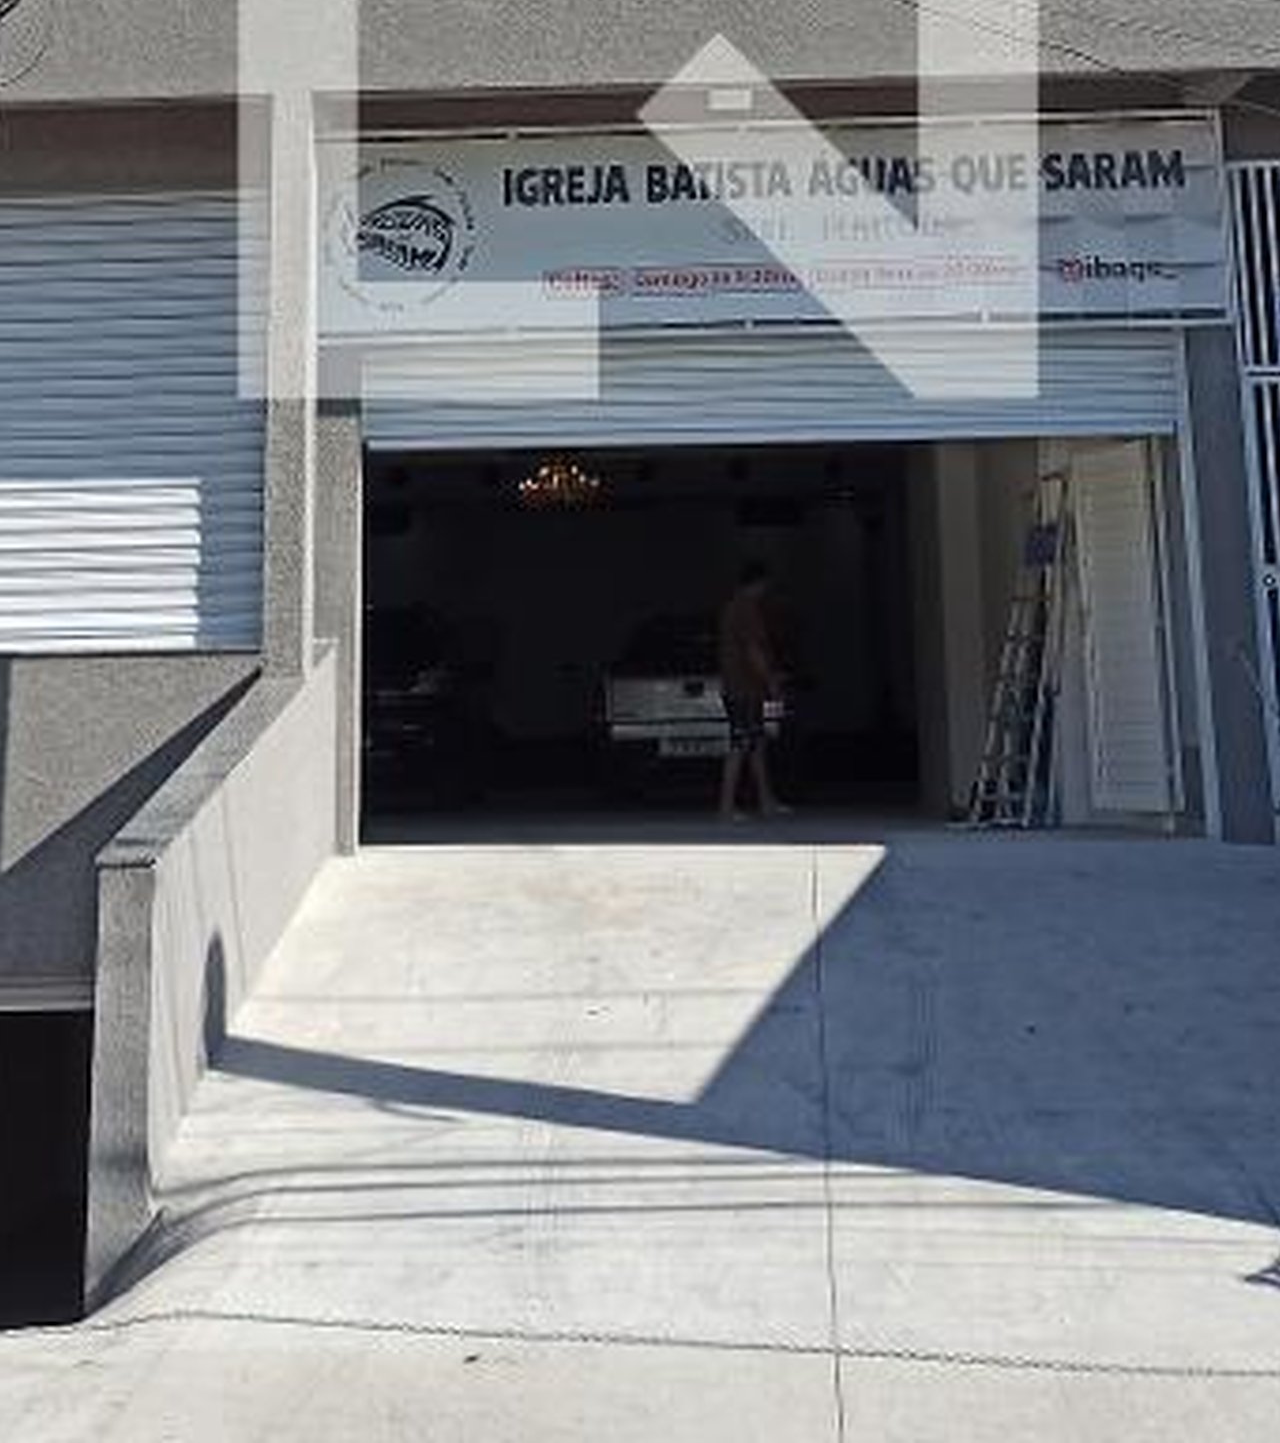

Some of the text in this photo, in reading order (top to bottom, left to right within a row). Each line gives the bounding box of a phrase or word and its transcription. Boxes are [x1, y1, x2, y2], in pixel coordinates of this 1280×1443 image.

[502, 165, 631, 207] IGREJA
[646, 160, 792, 205] BATISTA
[951, 154, 1028, 194] QUE
[1041, 149, 1187, 191] SARAM
